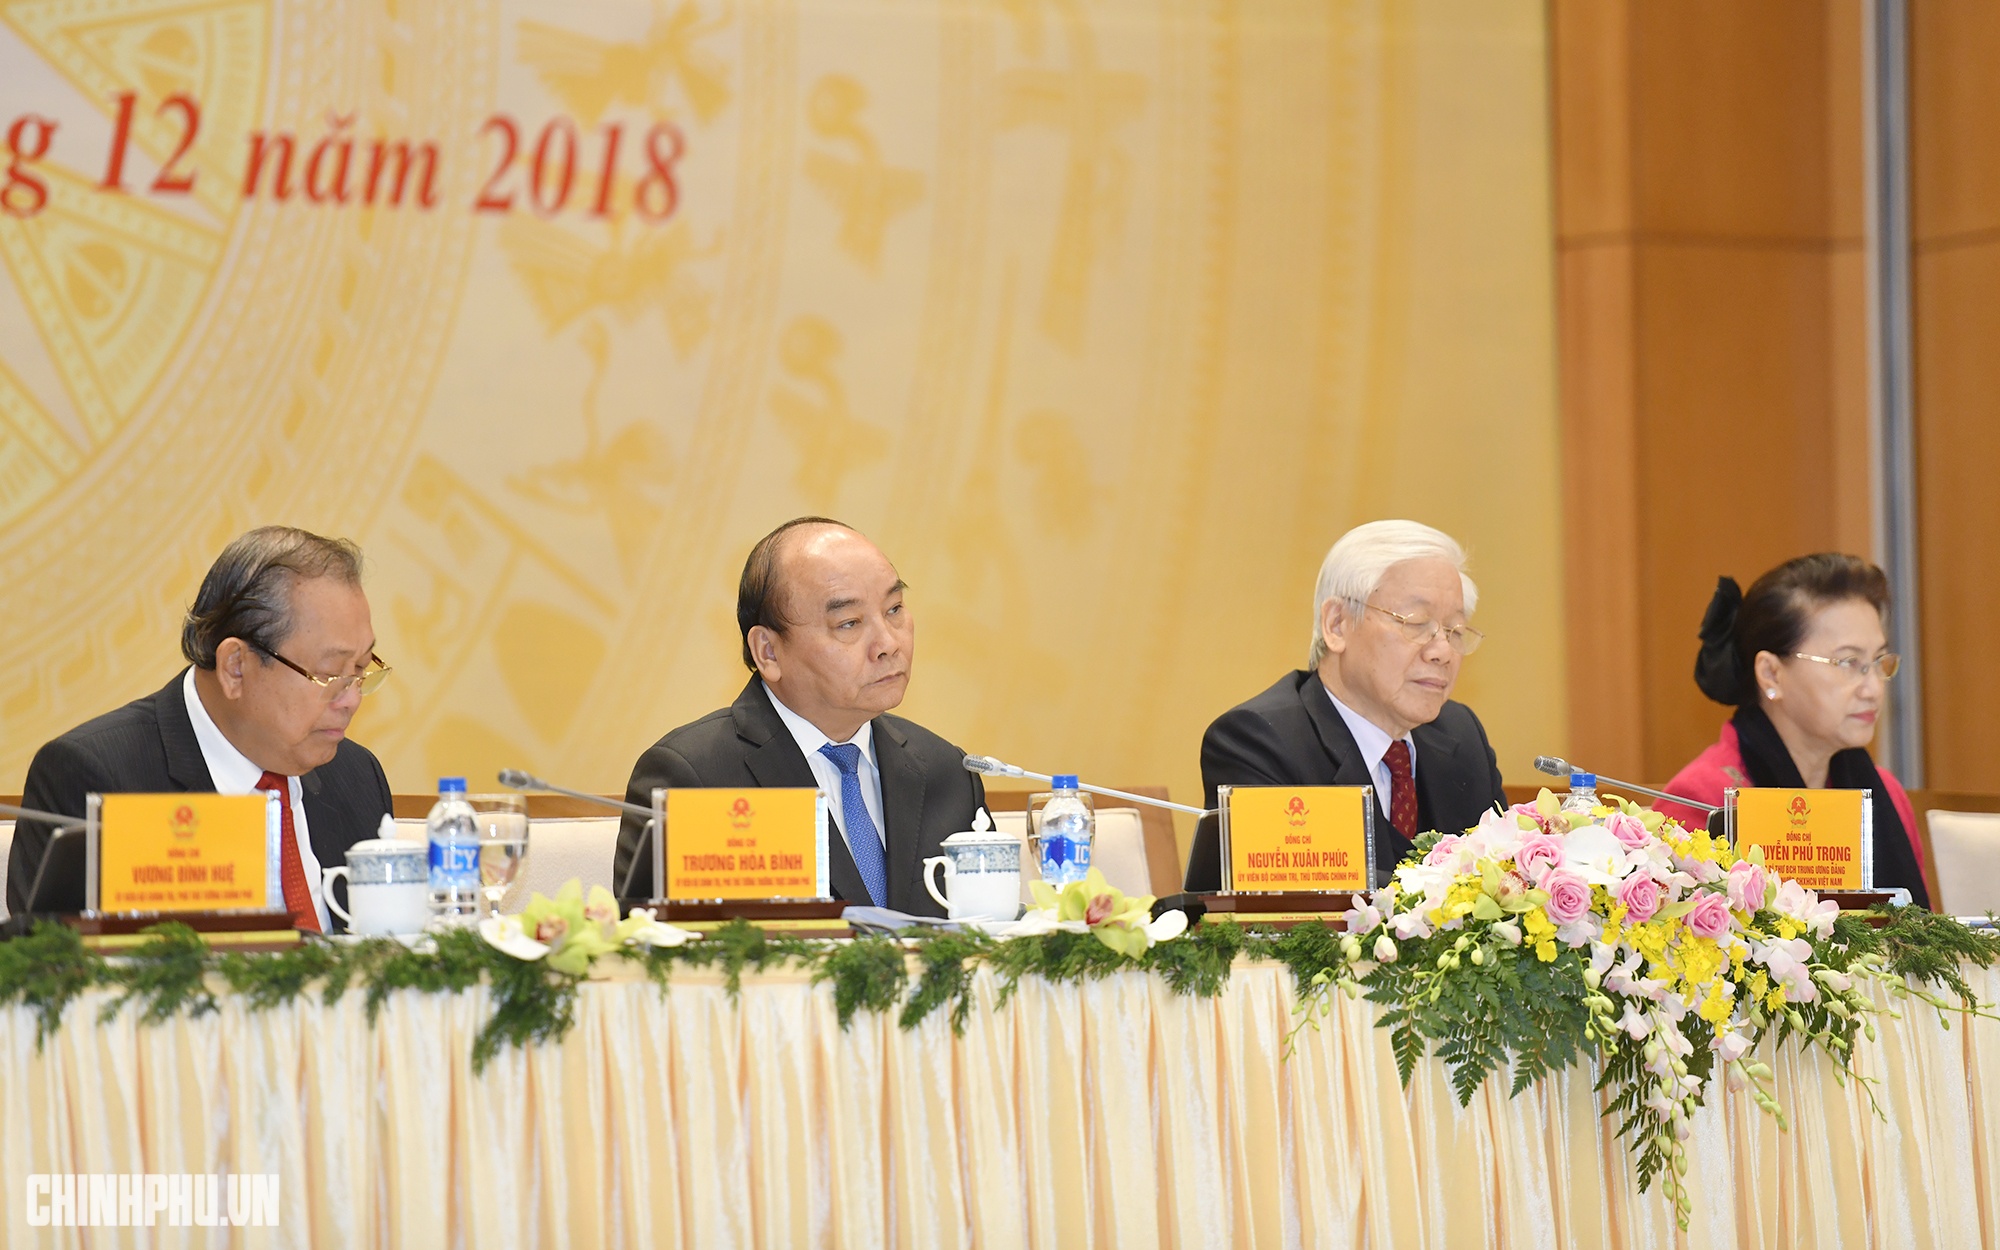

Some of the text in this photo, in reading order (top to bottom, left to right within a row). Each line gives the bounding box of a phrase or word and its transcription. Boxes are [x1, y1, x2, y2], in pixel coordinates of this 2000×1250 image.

[96, 88, 202, 195] 12
[243, 110, 440, 212] năm
[471, 111, 688, 227] 2018
[442, 848, 477, 870] ICY
[1248, 847, 1348, 868] NGUYỄN XUÂN PHÚC
[1748, 840, 1851, 865] UYỄN PHÚ TRỌNG
